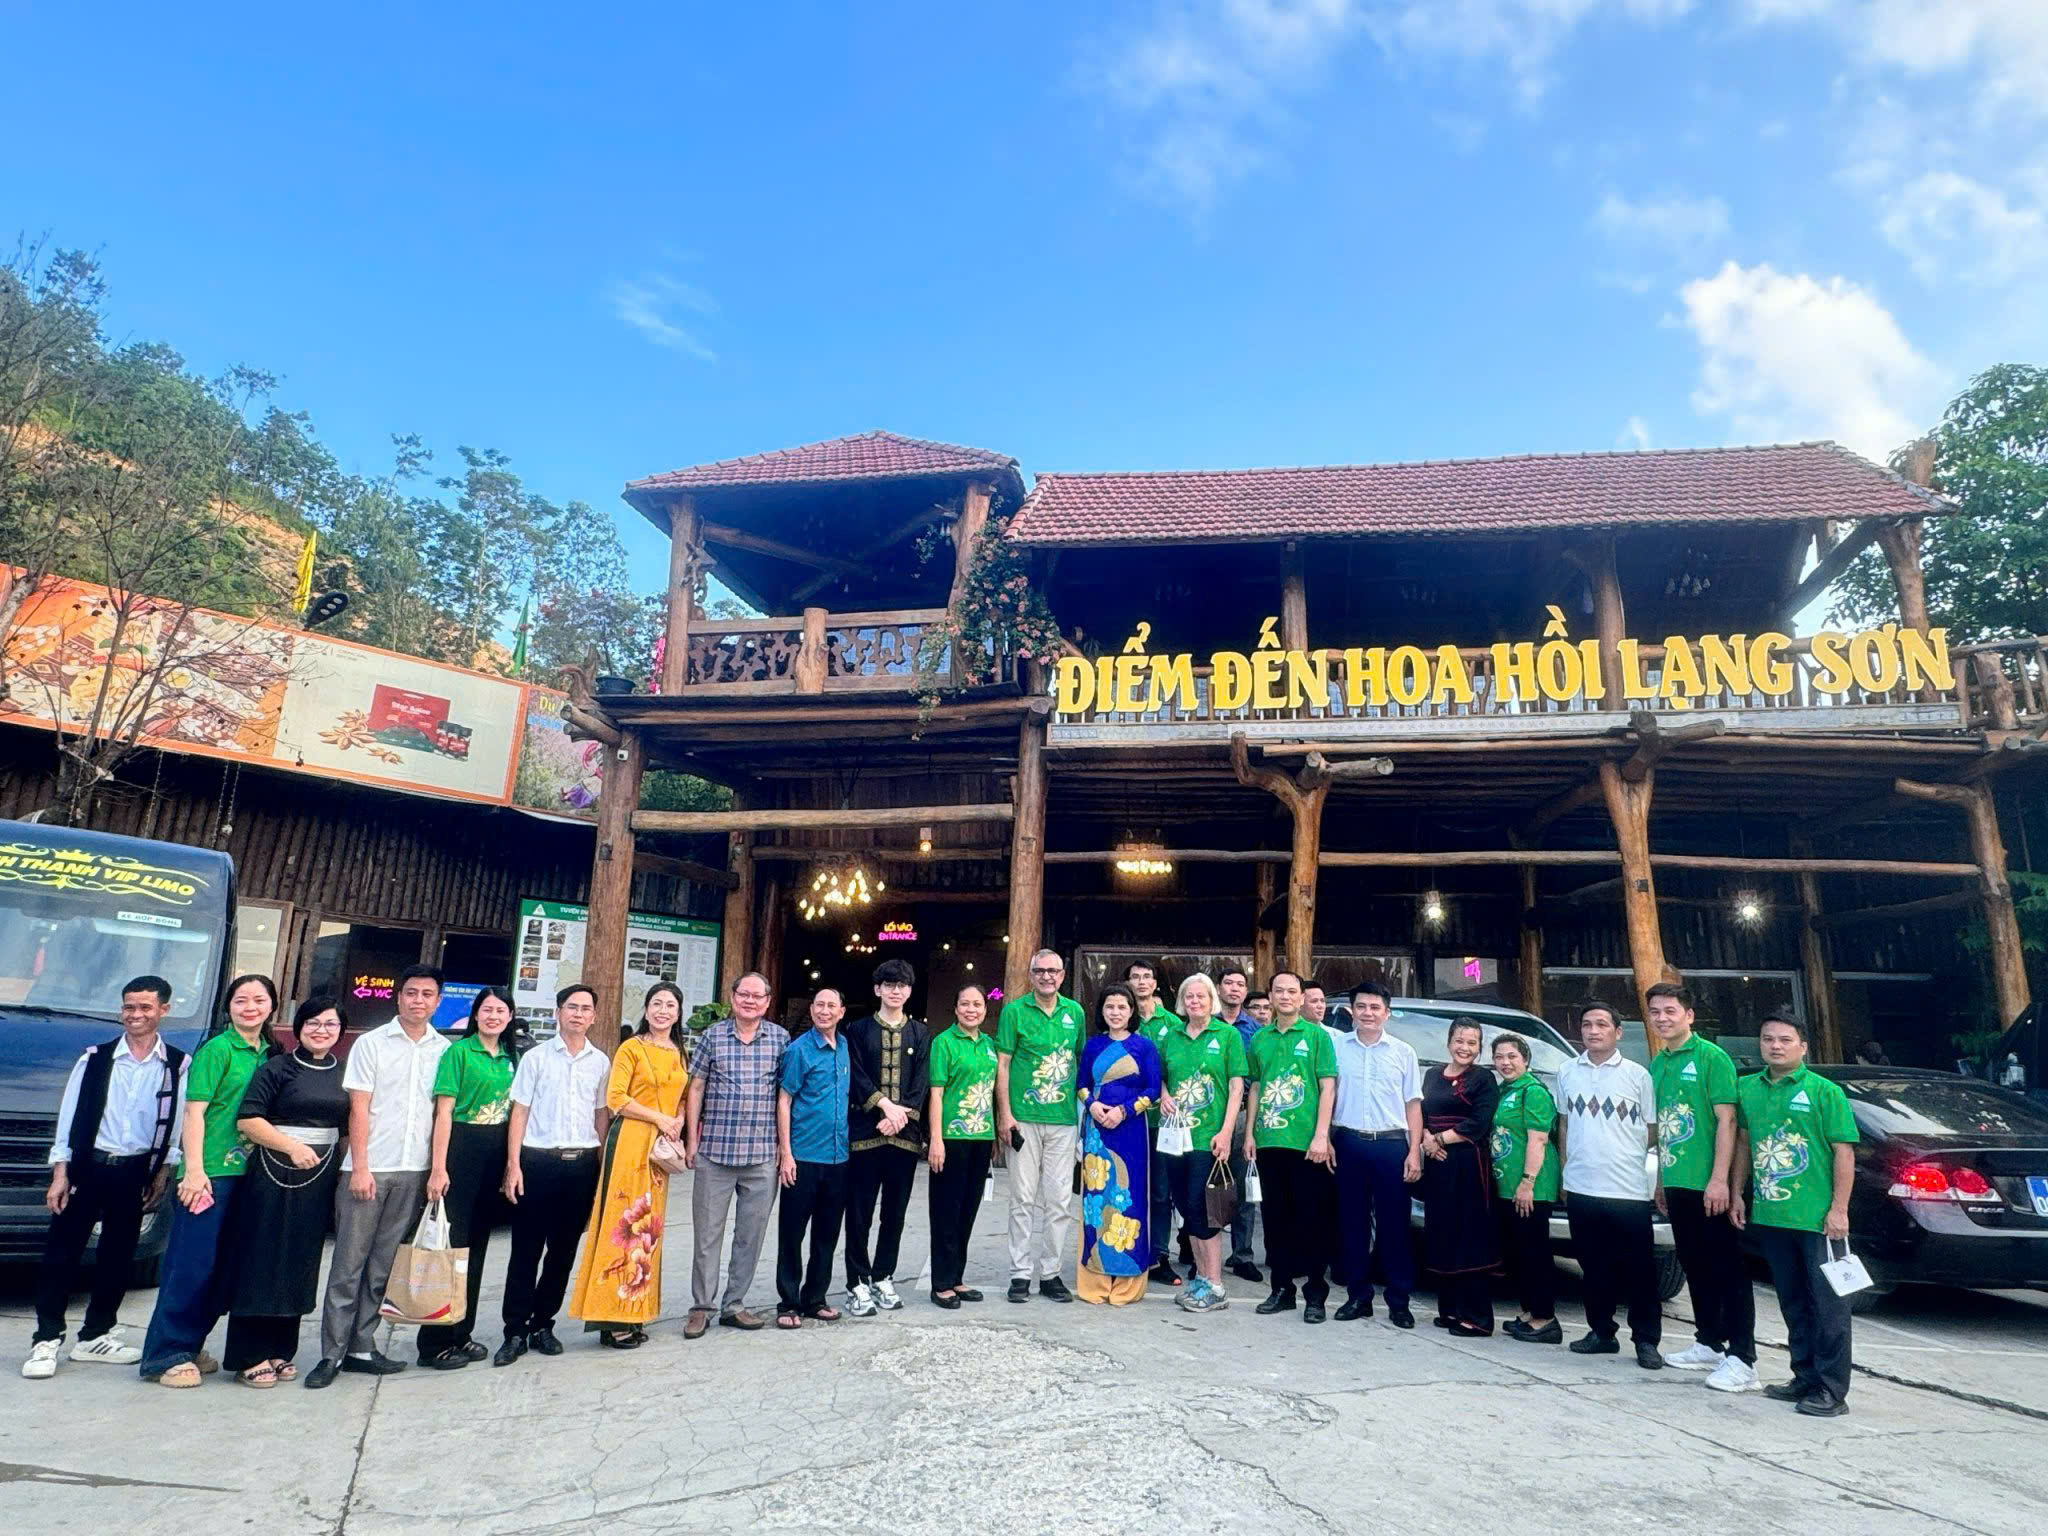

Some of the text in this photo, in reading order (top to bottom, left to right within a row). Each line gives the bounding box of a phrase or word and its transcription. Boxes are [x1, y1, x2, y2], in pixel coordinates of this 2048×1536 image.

[1056, 604, 1957, 714] ĐIỂM ĐẾN HOA HỒI LẠNG SƠN
[19, 858, 101, 876] THANH
[103, 867, 141, 883] VIP
[139, 875, 196, 896] LIMO
[879, 932, 918, 941] ENTRANCE
[370, 977, 395, 988] SINH
[374, 989, 393, 999] WC
